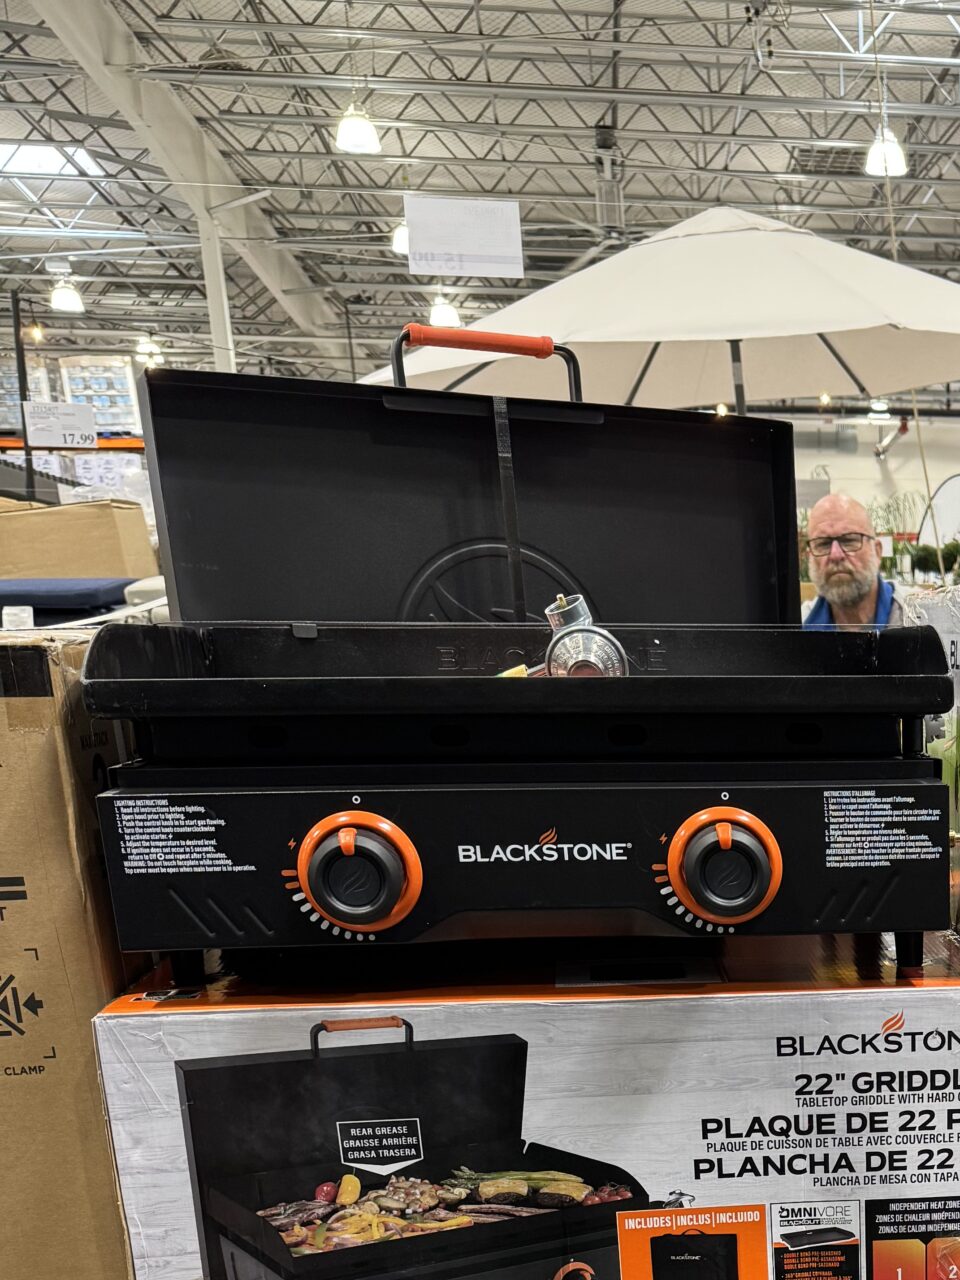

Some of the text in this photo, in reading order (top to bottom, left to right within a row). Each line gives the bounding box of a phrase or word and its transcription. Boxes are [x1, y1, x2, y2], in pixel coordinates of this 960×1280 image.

[61, 433, 95, 445] 17.99
[458, 843, 628, 862] BLACKSTONE
[4, 1065, 45, 1076] CLAMP
[795, 1073, 845, 1096] 22"
[701, 1113, 836, 1140] PLAQUE
[846, 1111, 888, 1134] DE
[898, 1109, 936, 1132] 22
[693, 1152, 856, 1180] PLANCHA
[865, 1150, 907, 1172] DE
[917, 1148, 955, 1170] 22
